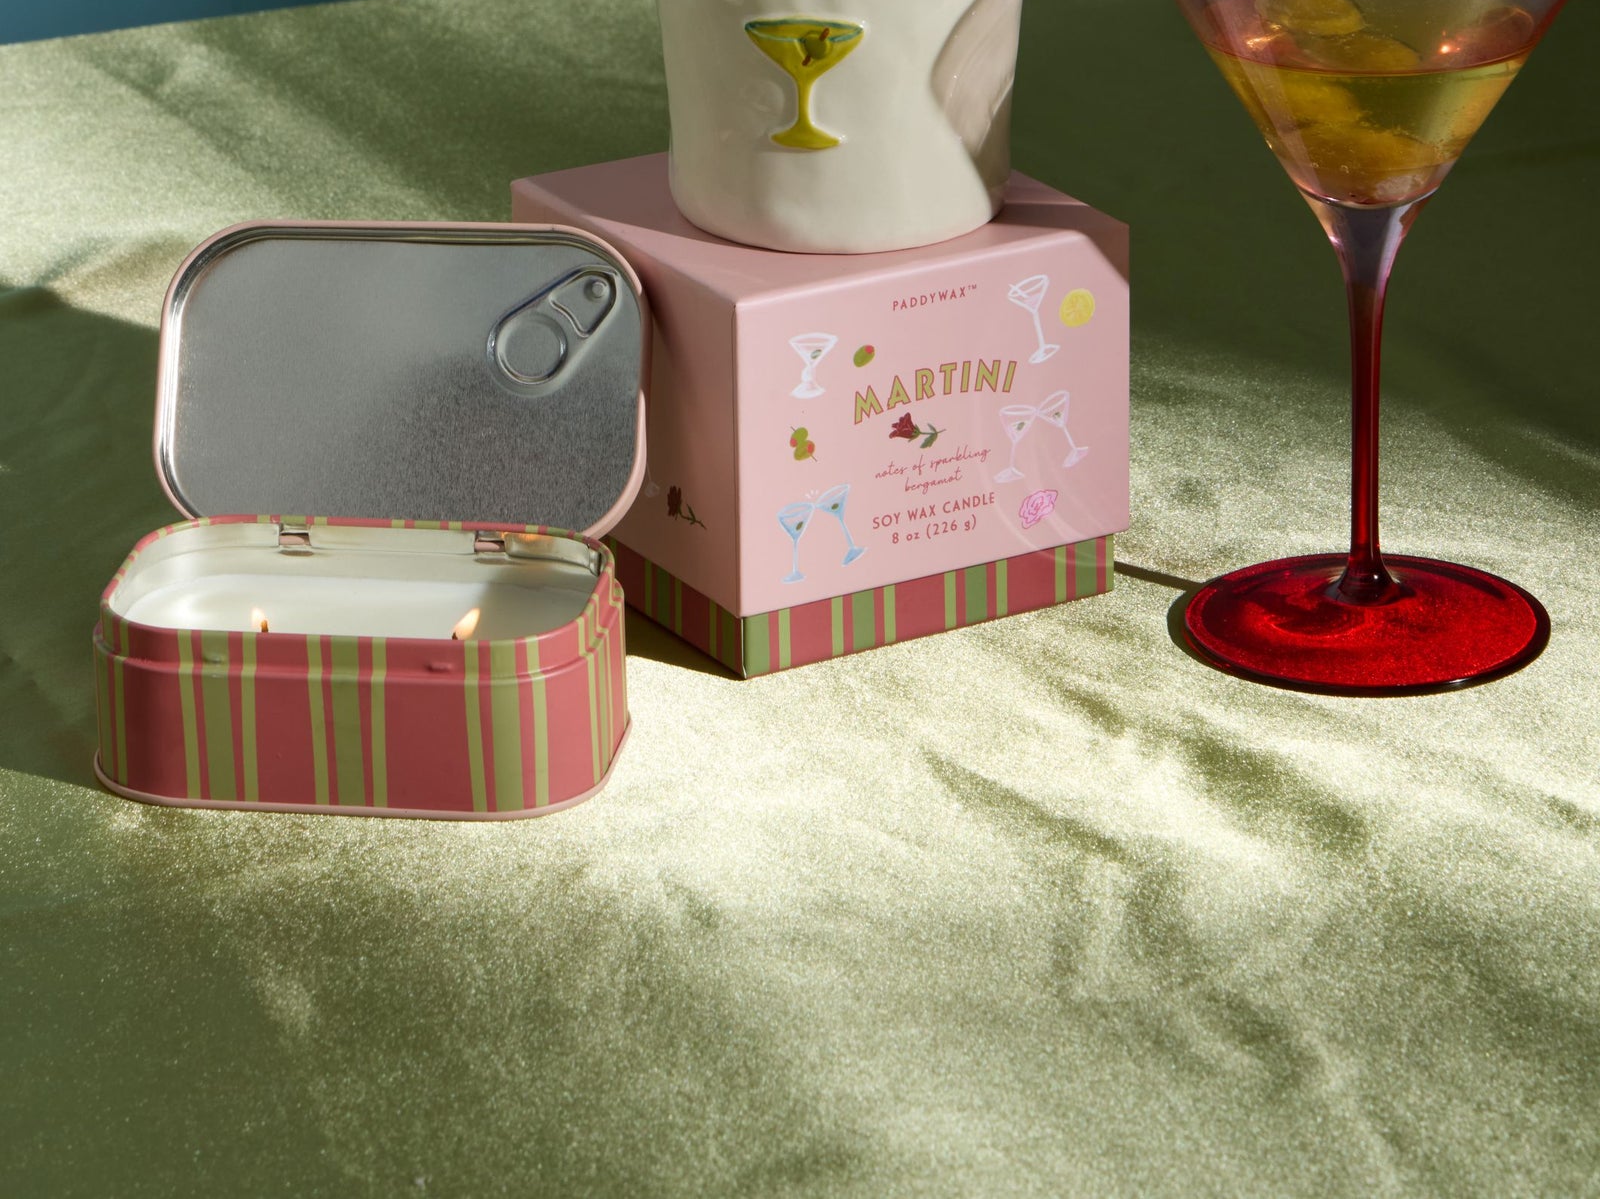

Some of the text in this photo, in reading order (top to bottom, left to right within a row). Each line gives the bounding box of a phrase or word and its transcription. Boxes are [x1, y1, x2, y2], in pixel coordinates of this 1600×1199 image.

[854, 359, 1017, 425] MARTINI
[875, 444, 991, 479] notes of sparkling
[904, 466, 963, 494] bergamot
[872, 492, 996, 530] SOY WAX CANDLE
[892, 514, 977, 544] 8 oz (226 g)
